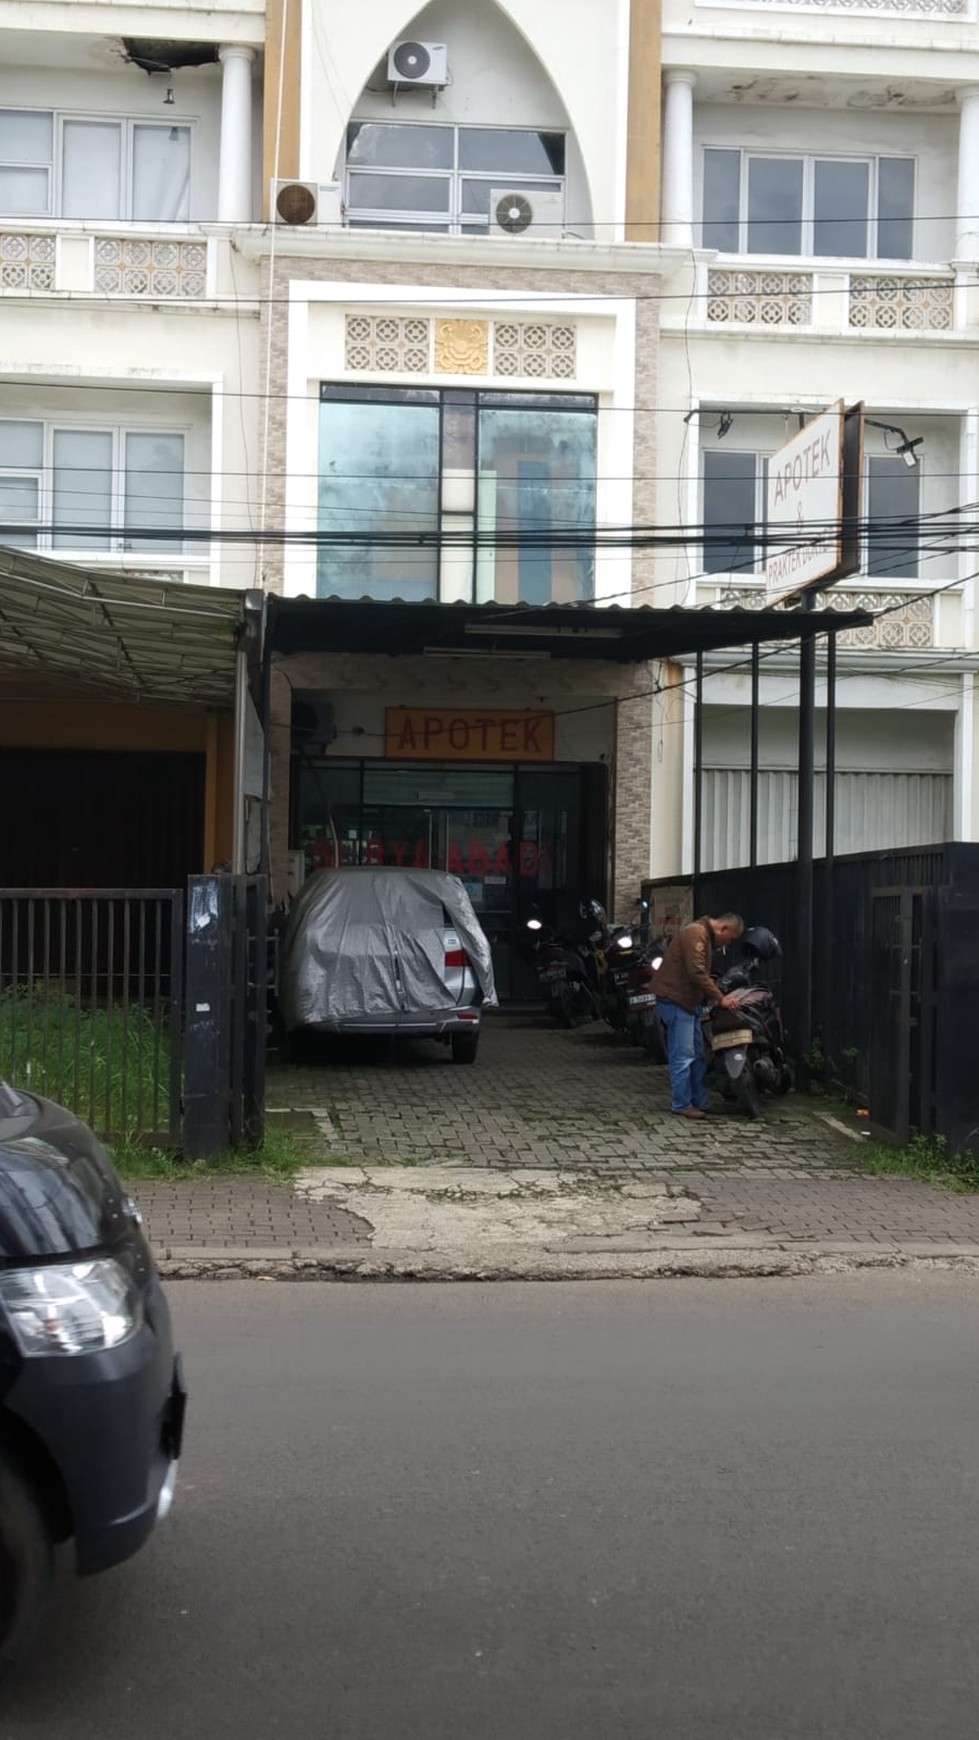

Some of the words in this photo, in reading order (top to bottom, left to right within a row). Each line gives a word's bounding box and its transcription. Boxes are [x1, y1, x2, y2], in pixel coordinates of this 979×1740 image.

[774, 428, 831, 507] APOTEK
[768, 548, 802, 587] PRAKTEK
[398, 716, 542, 752] APOTEK
[313, 838, 430, 870] SURYA
[448, 839, 552, 878] ABADI
